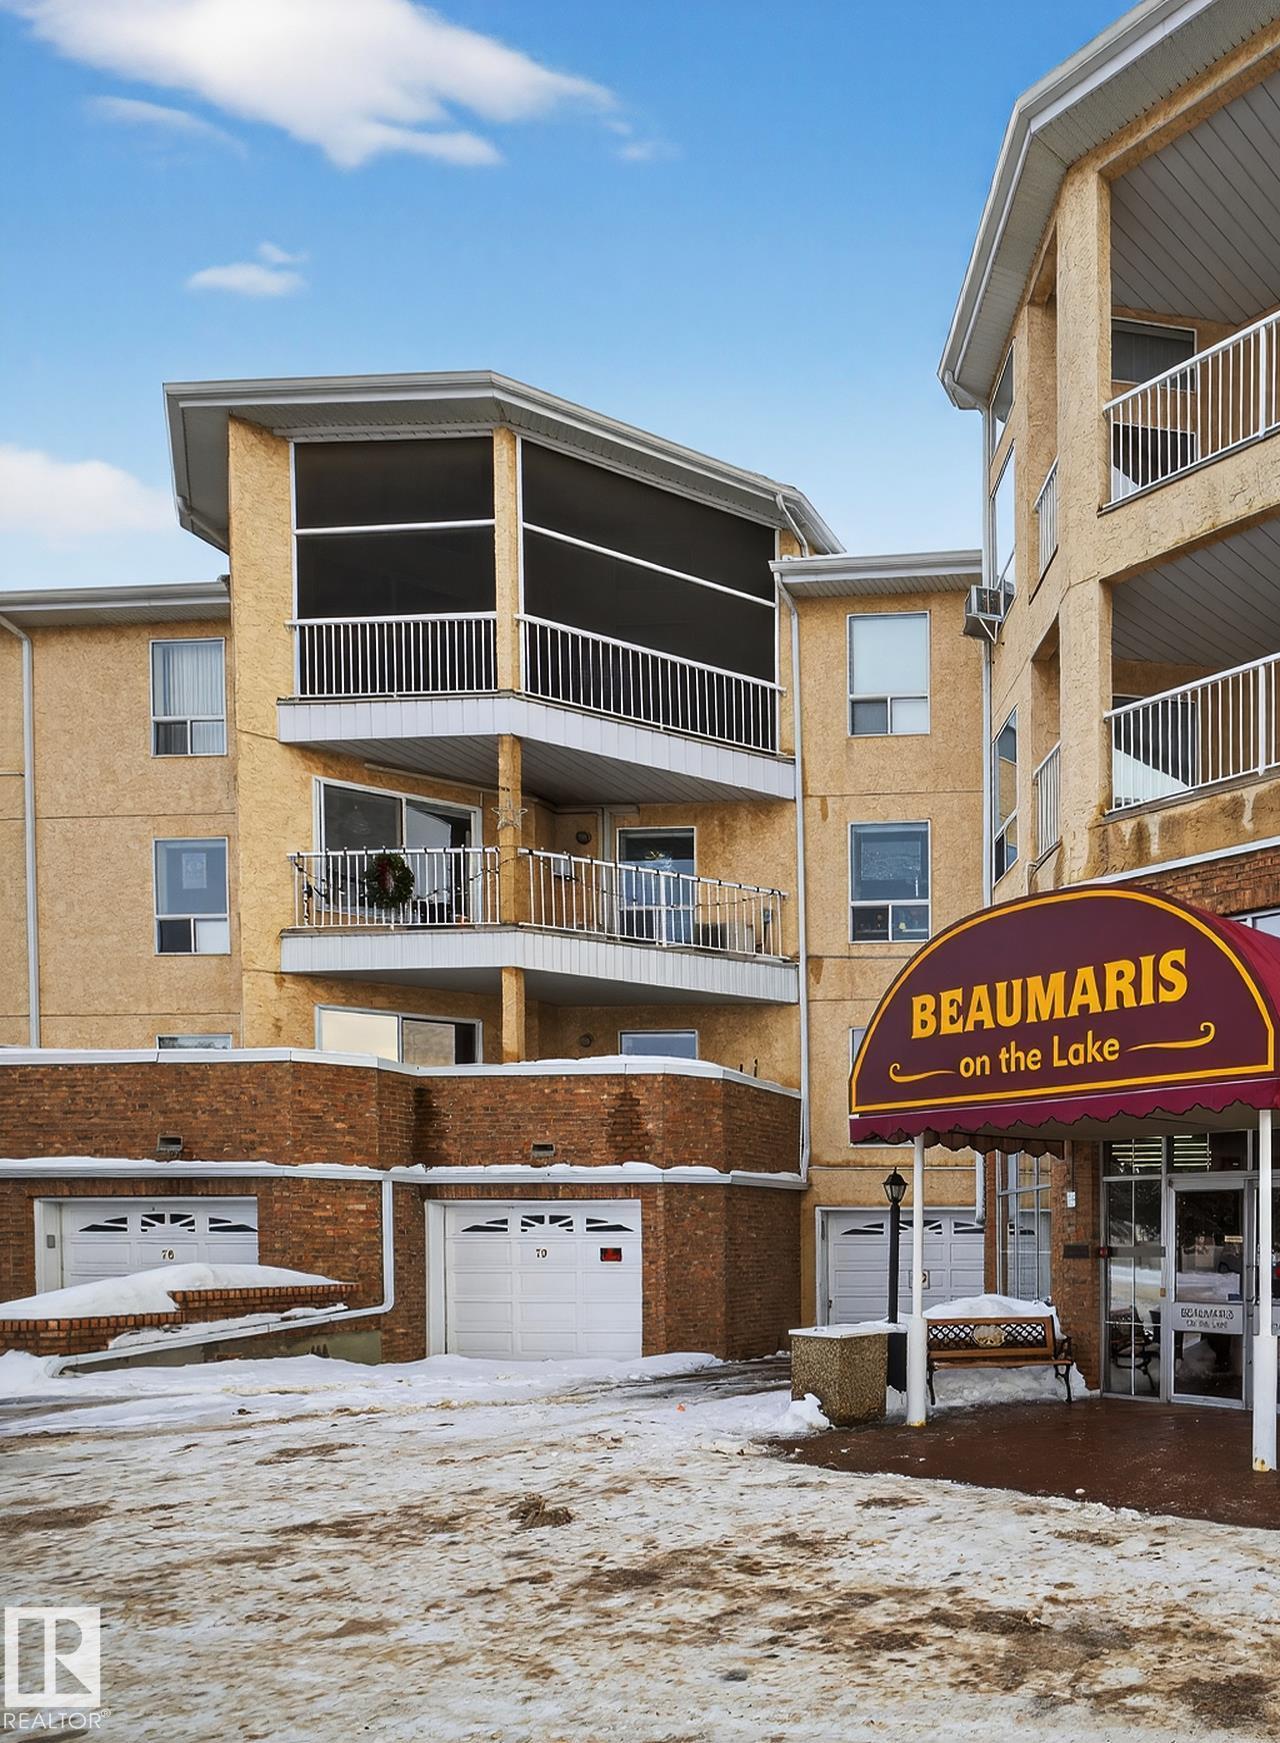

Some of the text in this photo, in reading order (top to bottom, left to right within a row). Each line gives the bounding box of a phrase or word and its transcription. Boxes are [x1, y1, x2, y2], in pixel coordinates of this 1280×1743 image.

[911, 948, 1188, 1039] BEAUMARIS
[960, 1031, 1120, 1078] on the Lake
